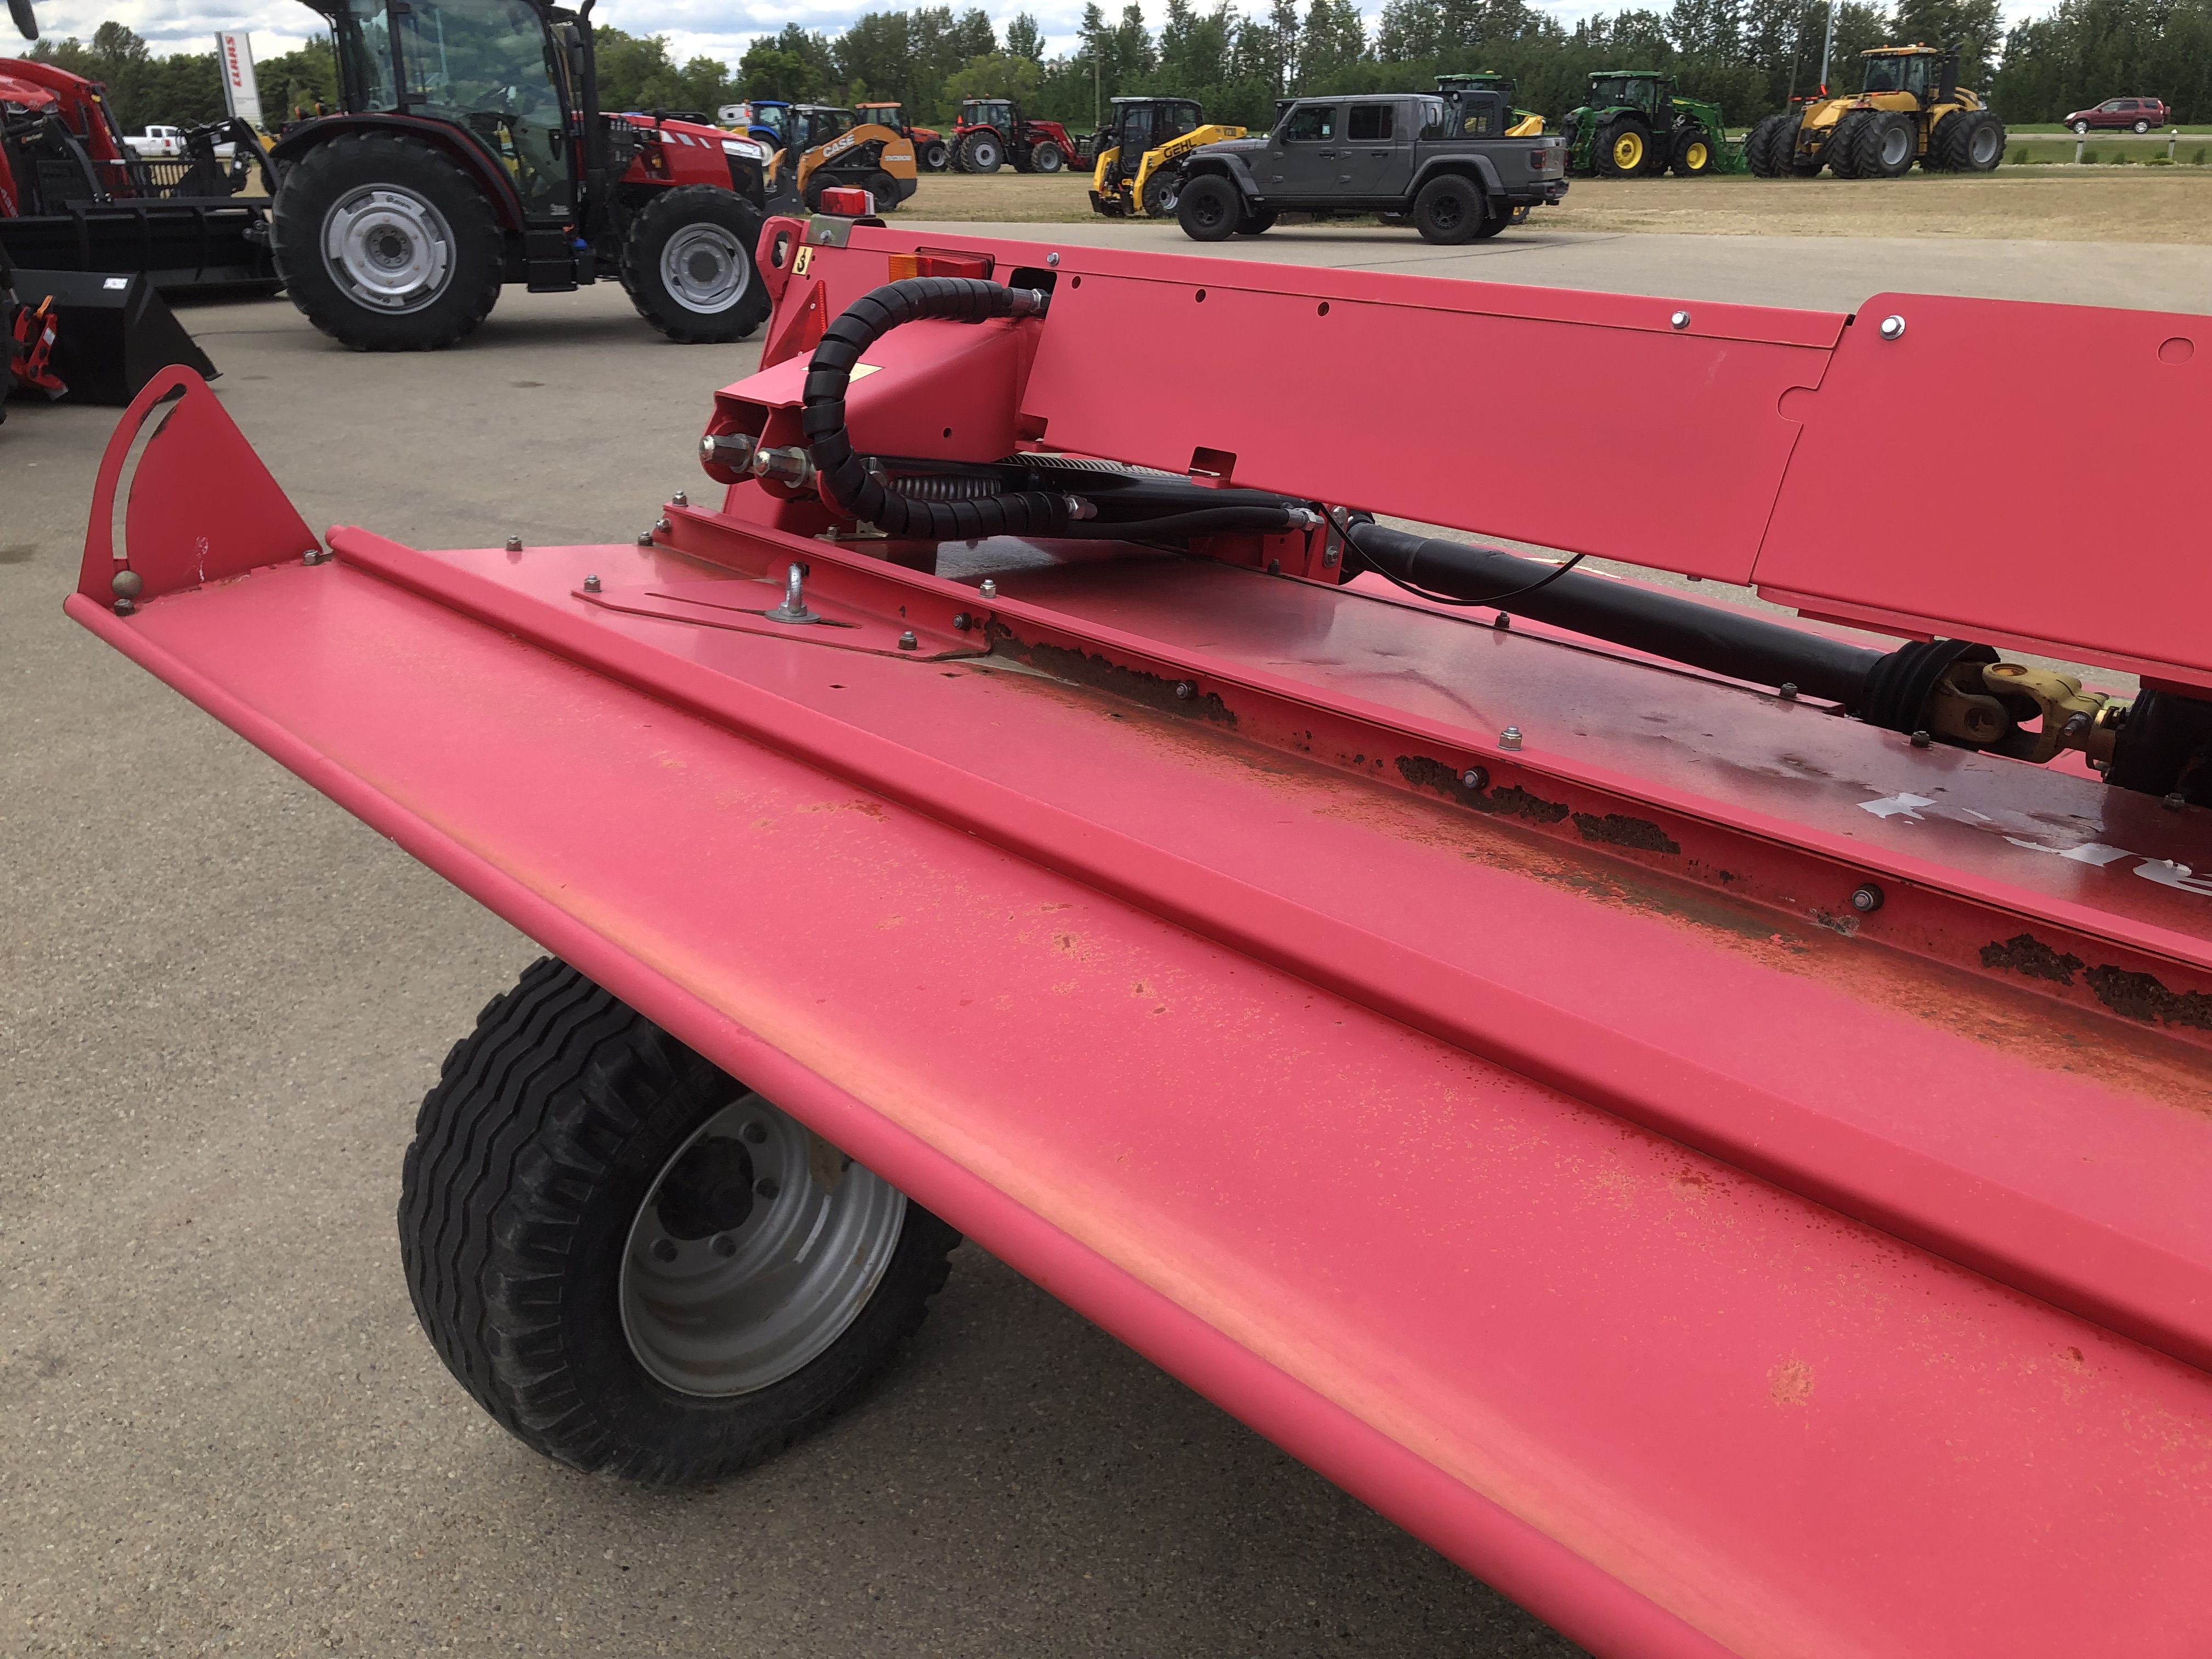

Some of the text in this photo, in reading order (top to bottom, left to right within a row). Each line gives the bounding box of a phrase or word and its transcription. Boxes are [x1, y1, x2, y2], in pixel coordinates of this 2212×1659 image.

[225, 36, 242, 87] CLAAS
[823, 134, 855, 157] CASE
[1164, 139, 1197, 158] GEHL
